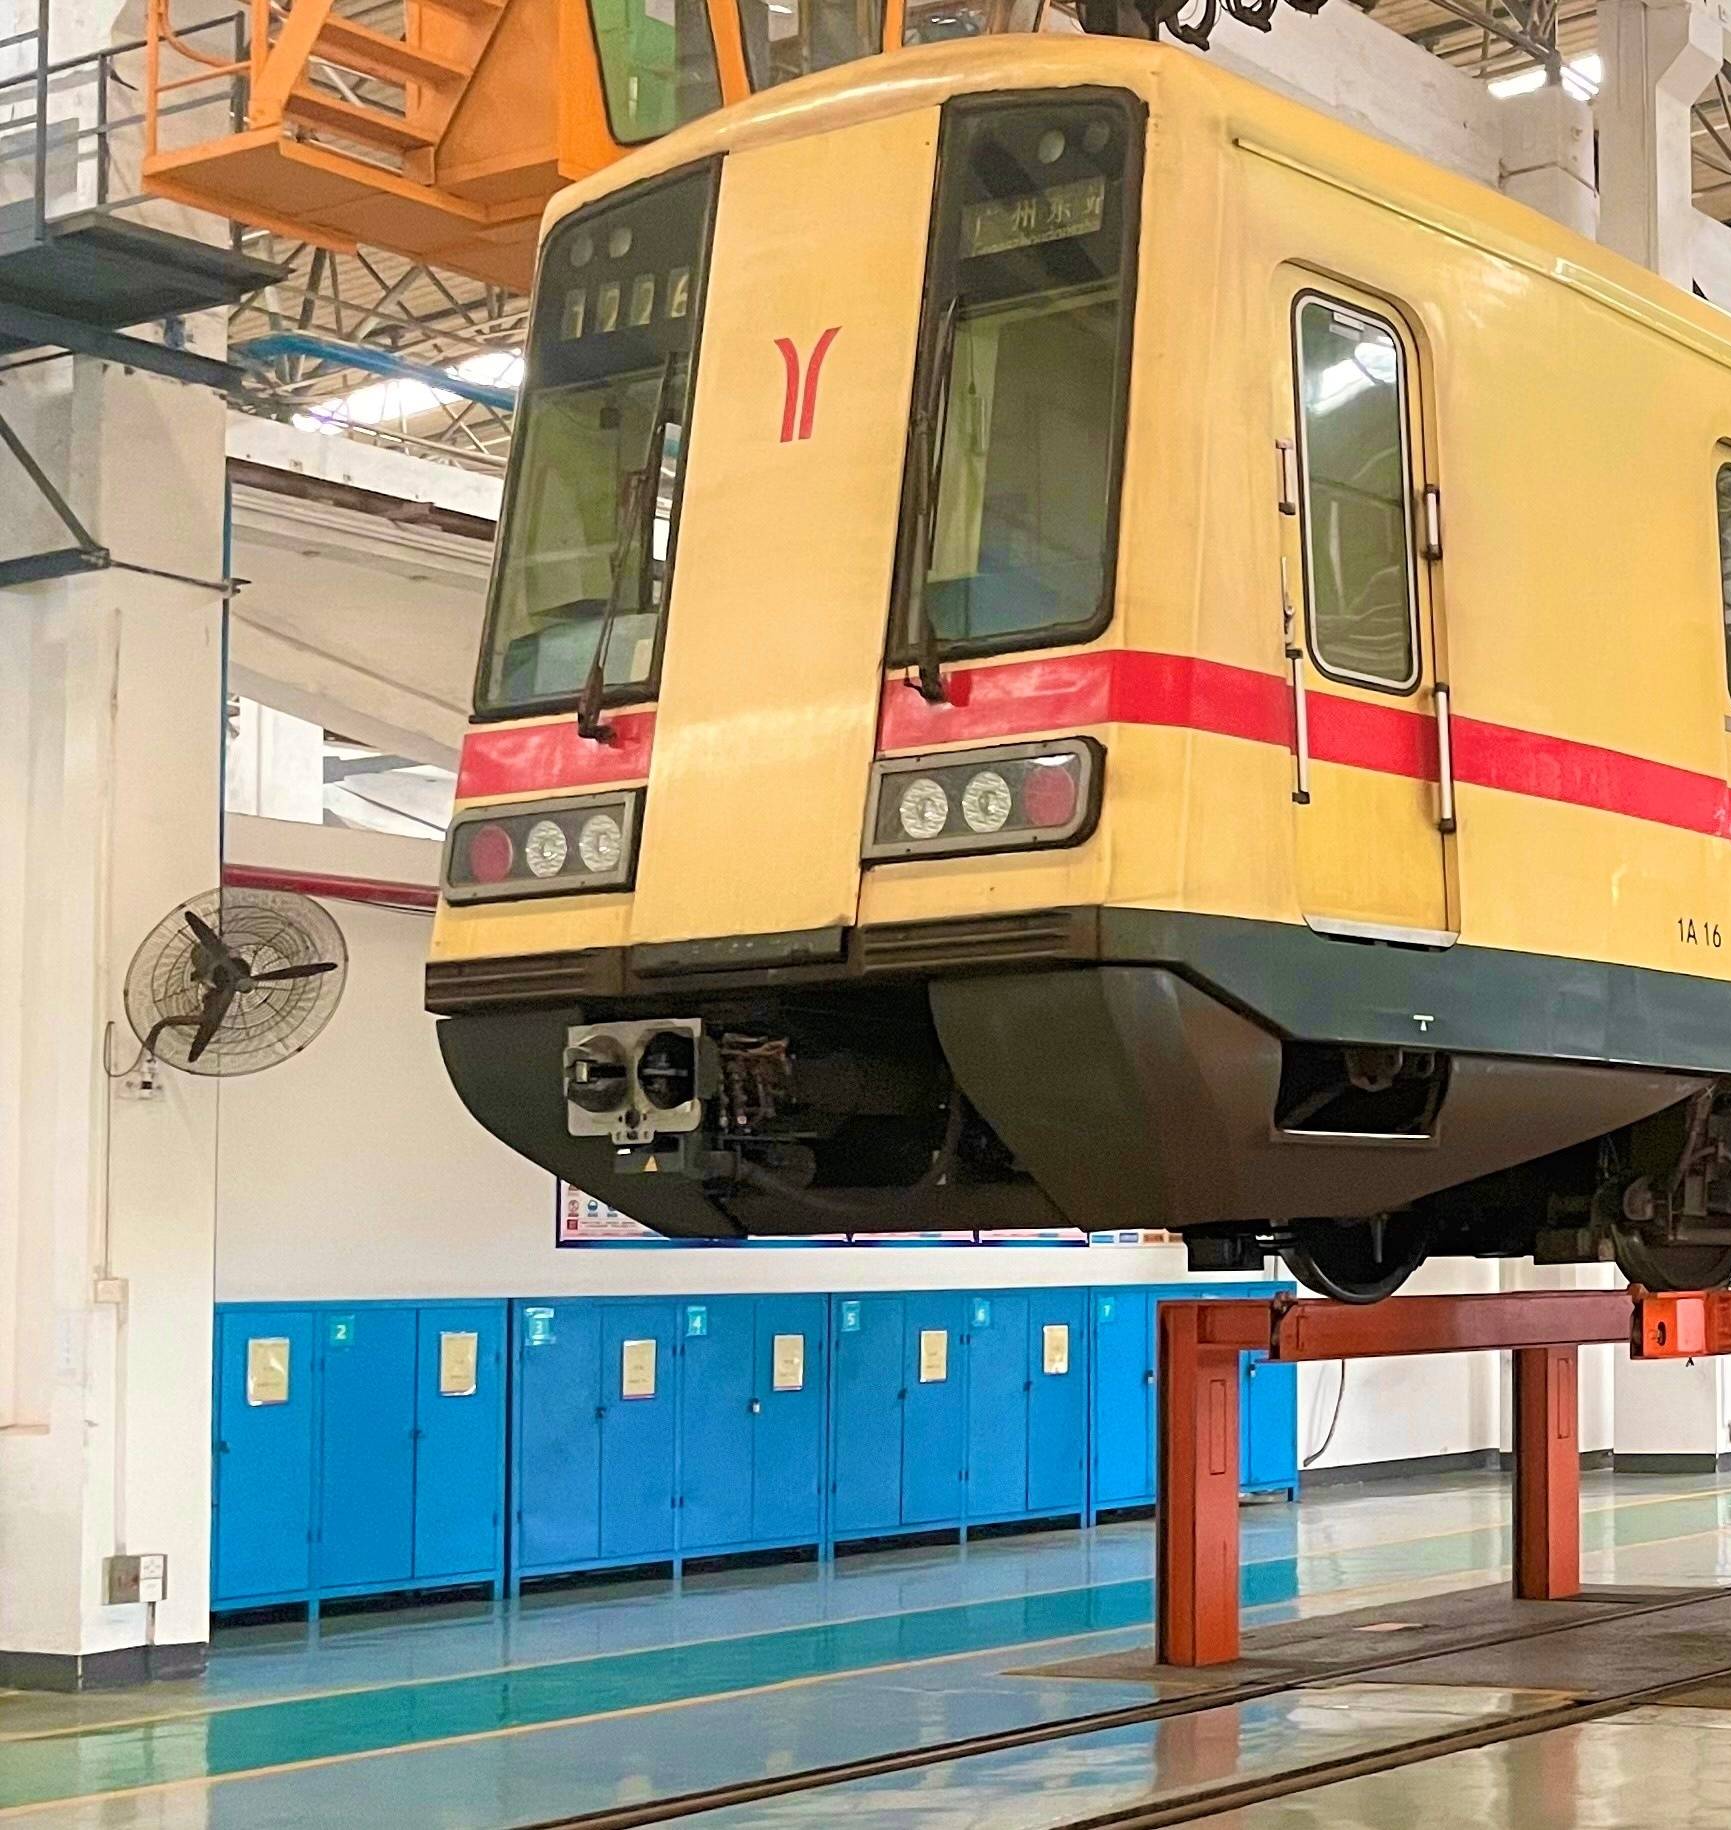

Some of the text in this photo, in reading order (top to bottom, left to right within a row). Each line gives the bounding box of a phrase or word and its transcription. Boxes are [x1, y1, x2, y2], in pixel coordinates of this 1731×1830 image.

[1678, 917, 1722, 948] 1A 16
[692, 1315, 702, 1335] 4
[847, 1311, 856, 1326] 5
[336, 1324, 347, 1340] 2
